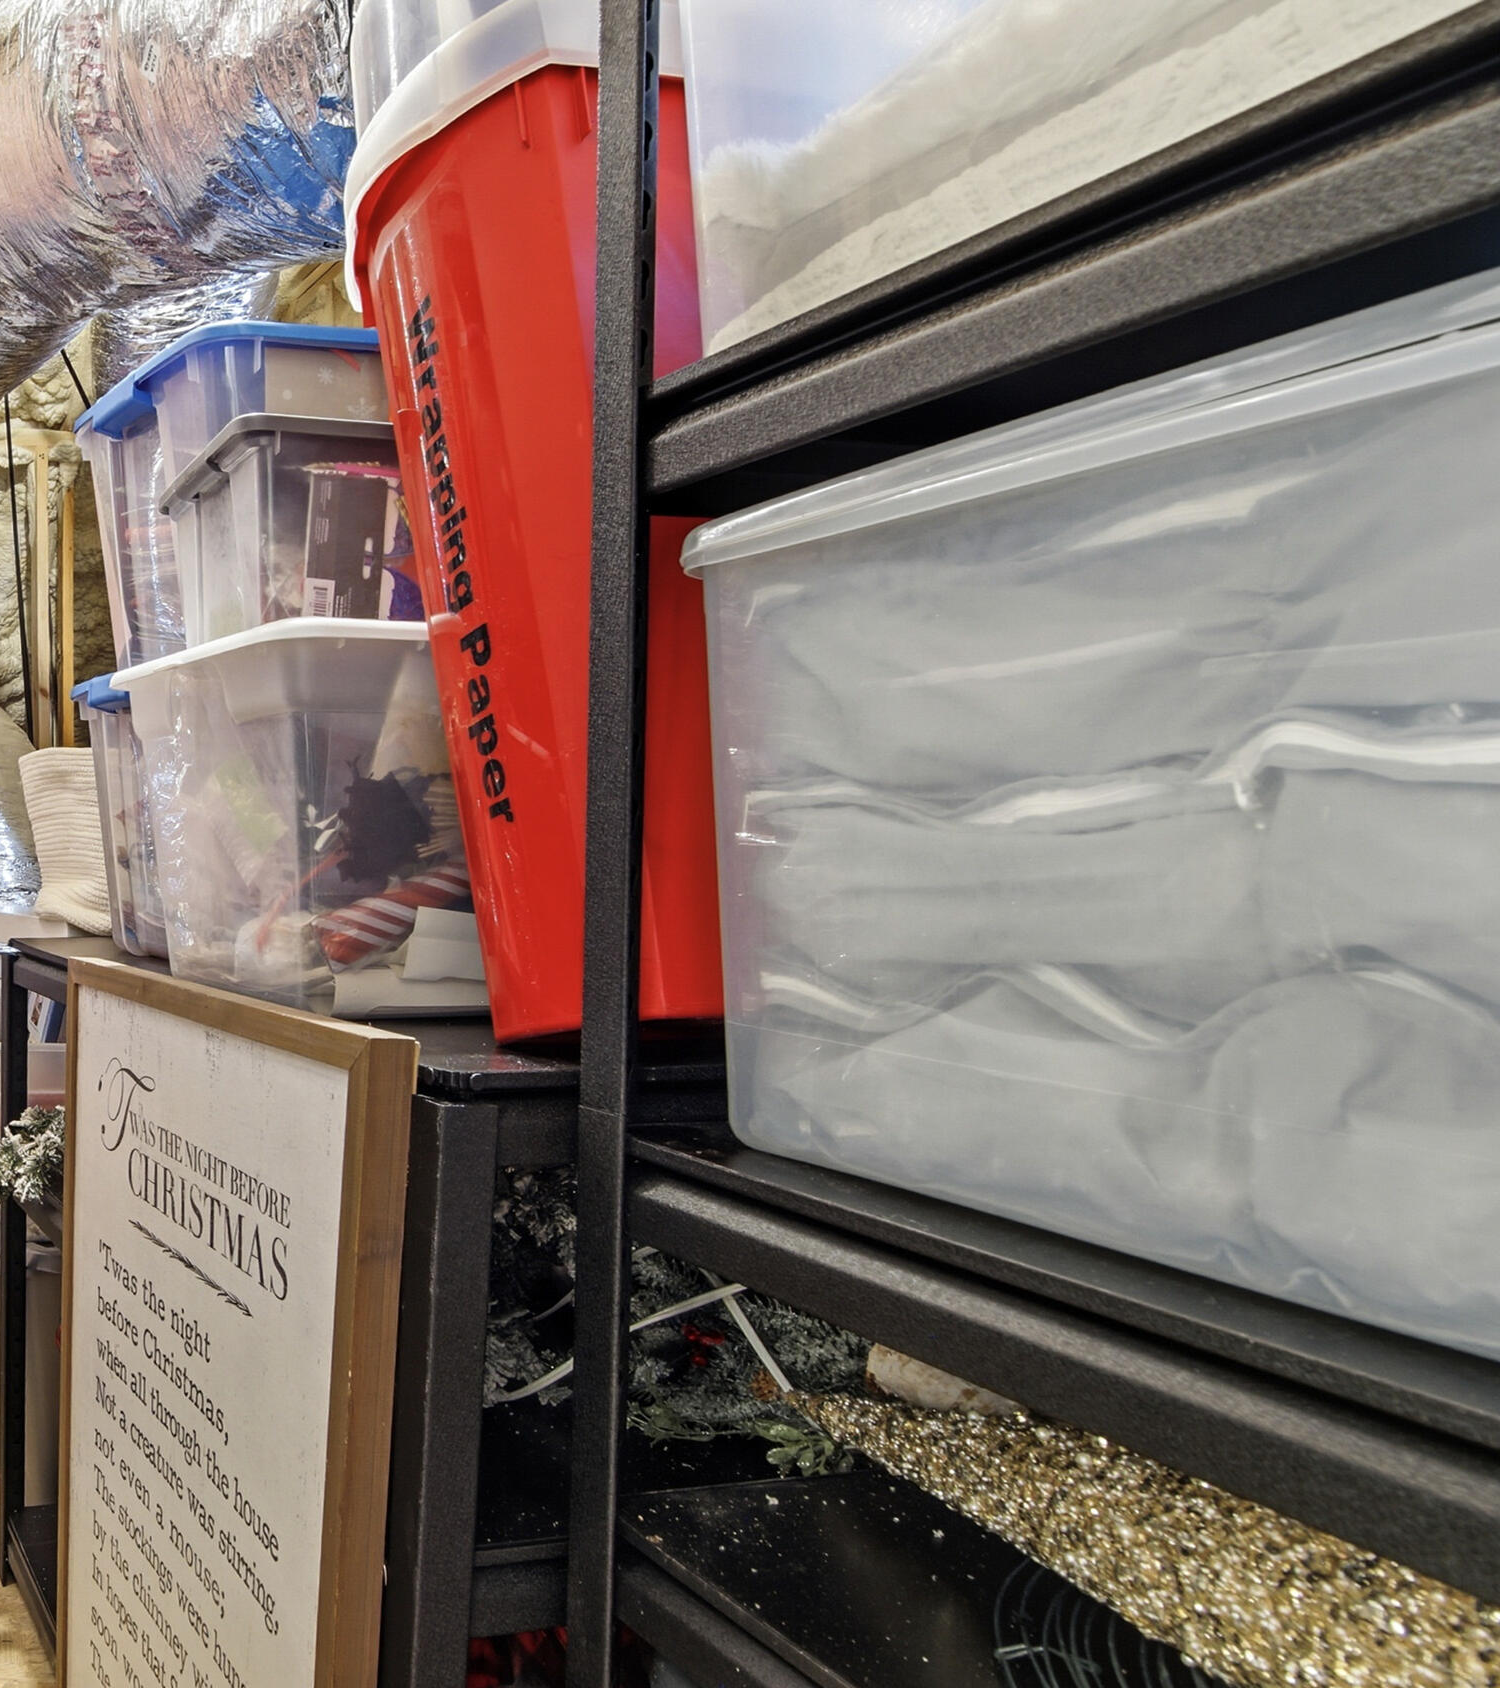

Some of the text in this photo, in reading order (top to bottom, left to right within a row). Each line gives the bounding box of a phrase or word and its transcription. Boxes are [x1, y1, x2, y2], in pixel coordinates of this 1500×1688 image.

[408, 294, 514, 823] Wrapping Paper
[128, 1148, 288, 1300] CHRISTMAS
[157, 1126, 183, 1163] THE
[185, 1139, 228, 1189] NIGHT
[230, 1165, 291, 1229] BEFORE
[97, 1286, 229, 1446] before Christmas,
[142, 1278, 166, 1321] the
[170, 1307, 211, 1363] night
[94, 1428, 225, 1619] not even a mouse;
[95, 1375, 279, 1636] Not a creature was stirring,
[96, 1338, 279, 1562] when all through the house
[91, 1606, 118, 1662] soon
[92, 1552, 103, 1591] In
[106, 1573, 139, 1643] hopes
[141, 1630, 166, 1688] that
[93, 1463, 116, 1514] The
[118, 1504, 173, 1595] stockings
[176, 1581, 209, 1649] were
[212, 1628, 246, 1688] hun
[93, 1509, 107, 1552] by
[110, 1535, 129, 1581] the
[132, 1572, 189, 1675] chimney
[90, 1640, 111, 1688] The
